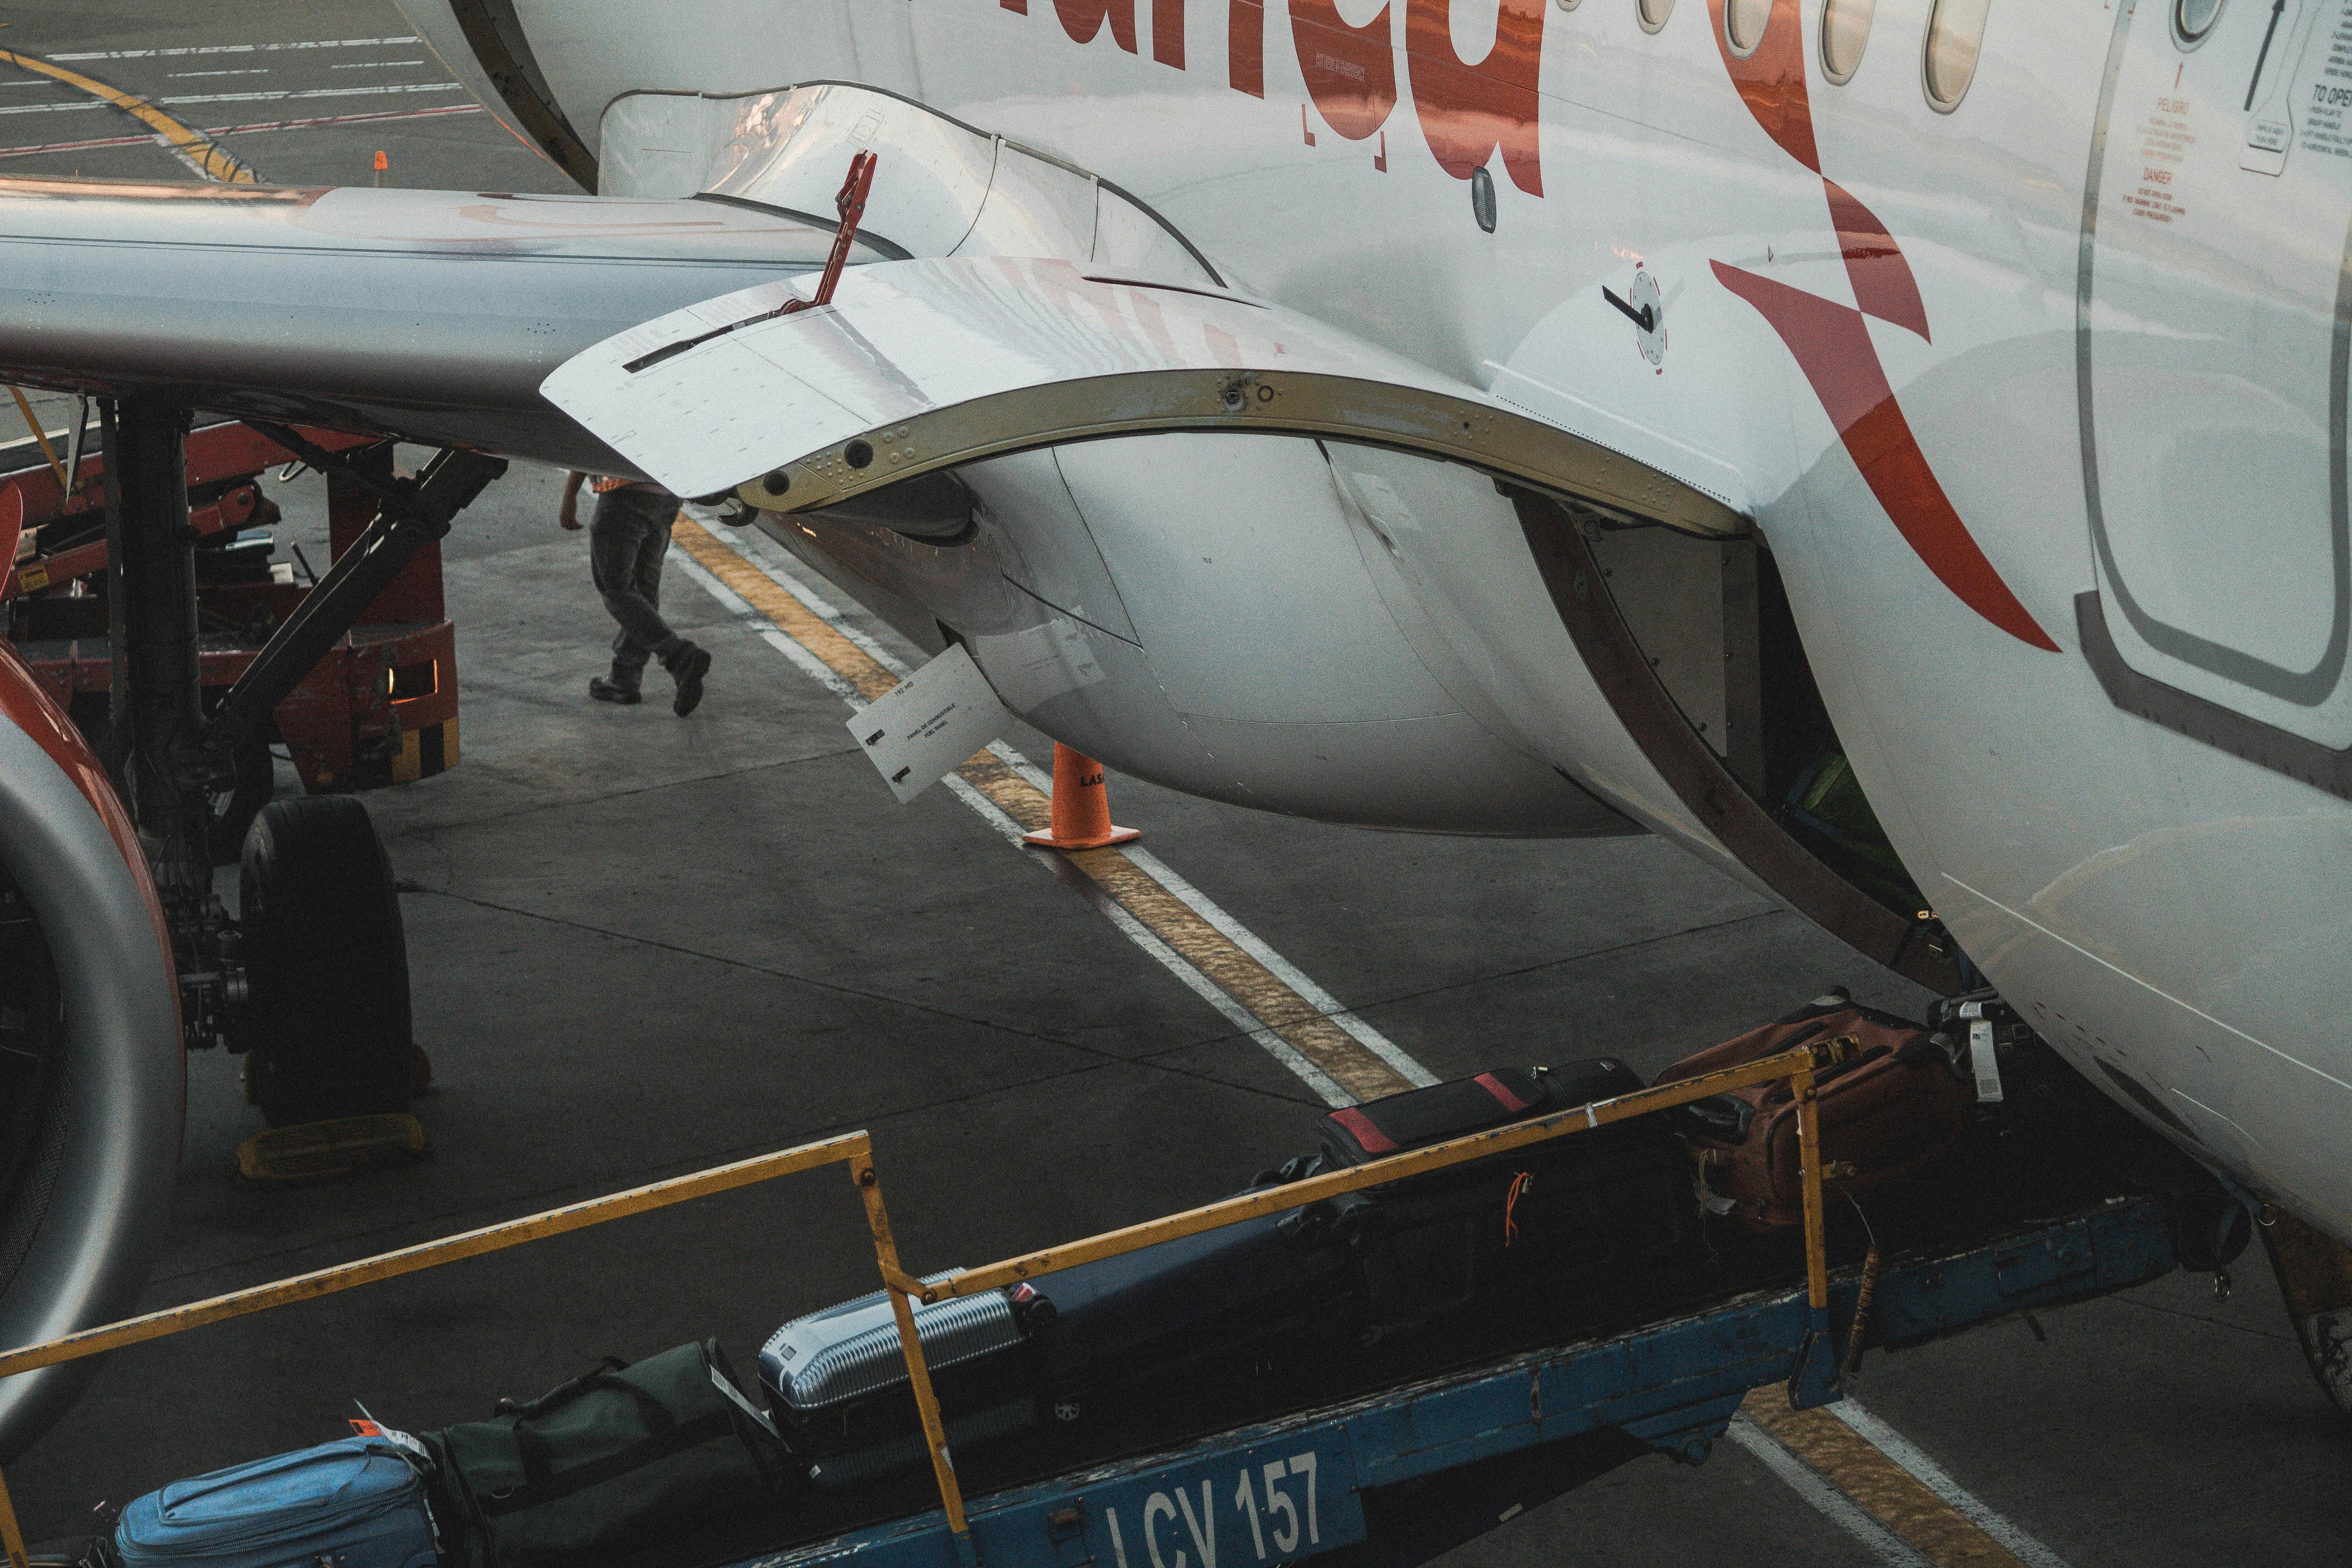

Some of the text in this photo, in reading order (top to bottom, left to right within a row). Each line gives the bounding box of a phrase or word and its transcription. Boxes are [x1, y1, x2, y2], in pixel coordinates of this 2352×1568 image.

[2313, 85, 2327, 102] TO
[2157, 97, 2190, 116] PELIGRO
[2143, 167, 2172, 186] DANGER
[904, 681, 913, 690] MB
[907, 729, 921, 740] PANEL
[927, 703, 956, 725] COMBUSTIBLE
[925, 720, 948, 739] FUEL PANEL
[1235, 1452, 1319, 1560] 157
